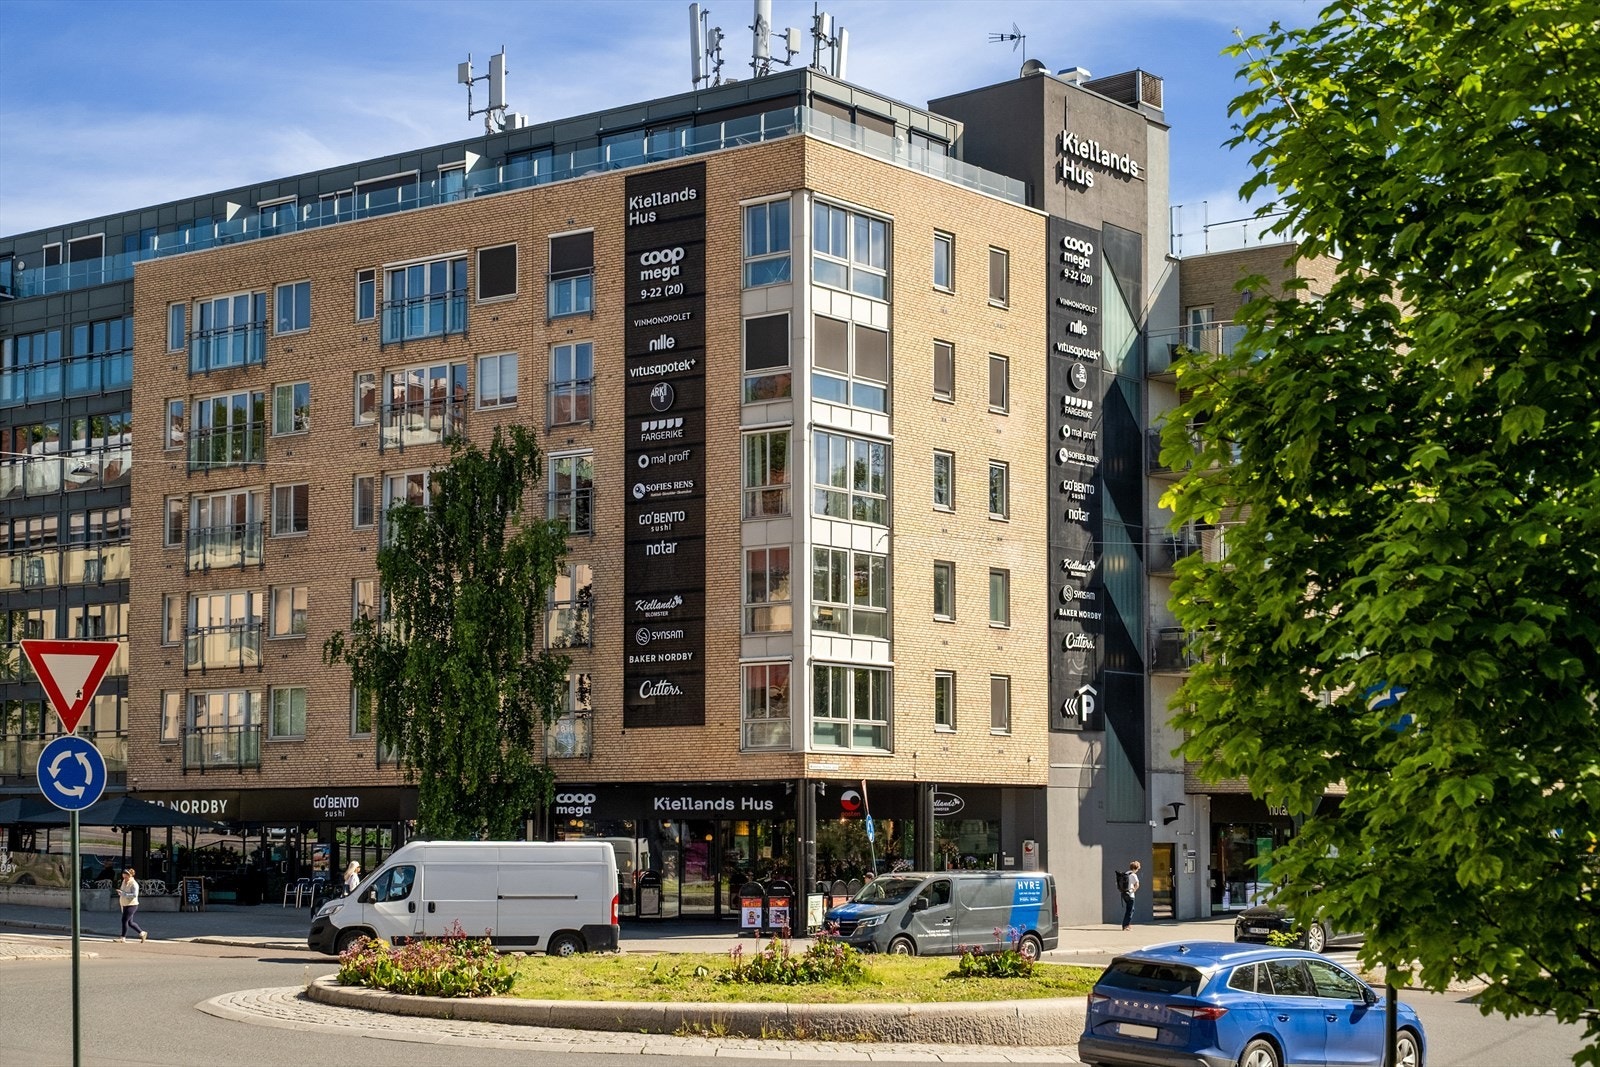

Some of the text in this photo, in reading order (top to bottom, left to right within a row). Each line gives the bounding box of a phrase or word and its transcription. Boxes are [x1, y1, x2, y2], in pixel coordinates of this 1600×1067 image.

[1062, 129, 1139, 177] Kiellands
[1062, 157, 1094, 188] Hus
[629, 187, 697, 210] Kiellands
[629, 211, 657, 226] Hus
[1064, 236, 1094, 256] coop
[640, 247, 685, 266] coop
[1064, 251, 1090, 269] mega
[640, 265, 680, 282] mega
[1064, 269, 1093, 286] 9-22 (20)
[641, 283, 684, 299] 9-22 (20)
[1060, 297, 1098, 314] VINMONOPOLET
[634, 312, 691, 327] VINMONOPOLET
[1070, 320, 1088, 336] nille
[649, 334, 675, 351] nille
[1065, 406, 1093, 420] FARGERIKE
[641, 428, 684, 441] FARGERIKE
[1071, 428, 1098, 442] mal proff
[651, 449, 691, 464] mal proff
[1068, 451, 1086, 461] SOFIES
[1086, 454, 1100, 464] RENS
[645, 480, 694, 492] SOFIES RENS
[1071, 493, 1086, 501] sushi
[1068, 508, 1090, 522] notar
[651, 523, 672, 532] sushi
[646, 541, 678, 556] notar
[635, 598, 677, 611] Kiellands
[1059, 608, 1102, 620] BAKER NORDBY
[629, 652, 693, 664] BAKER NORDBY
[639, 679, 683, 699] Cutters.
[1082, 694, 1095, 722] P
[556, 793, 596, 805] coop
[654, 797, 774, 811] Kiellands Hus
[170, 800, 227, 813] NORDBY
[325, 809, 346, 817] sushi
[556, 805, 592, 817] mega
[1269, 805, 1288, 816] nota
[0, 863, 17, 873] DBY
[1018, 881, 1041, 890] HYRE
